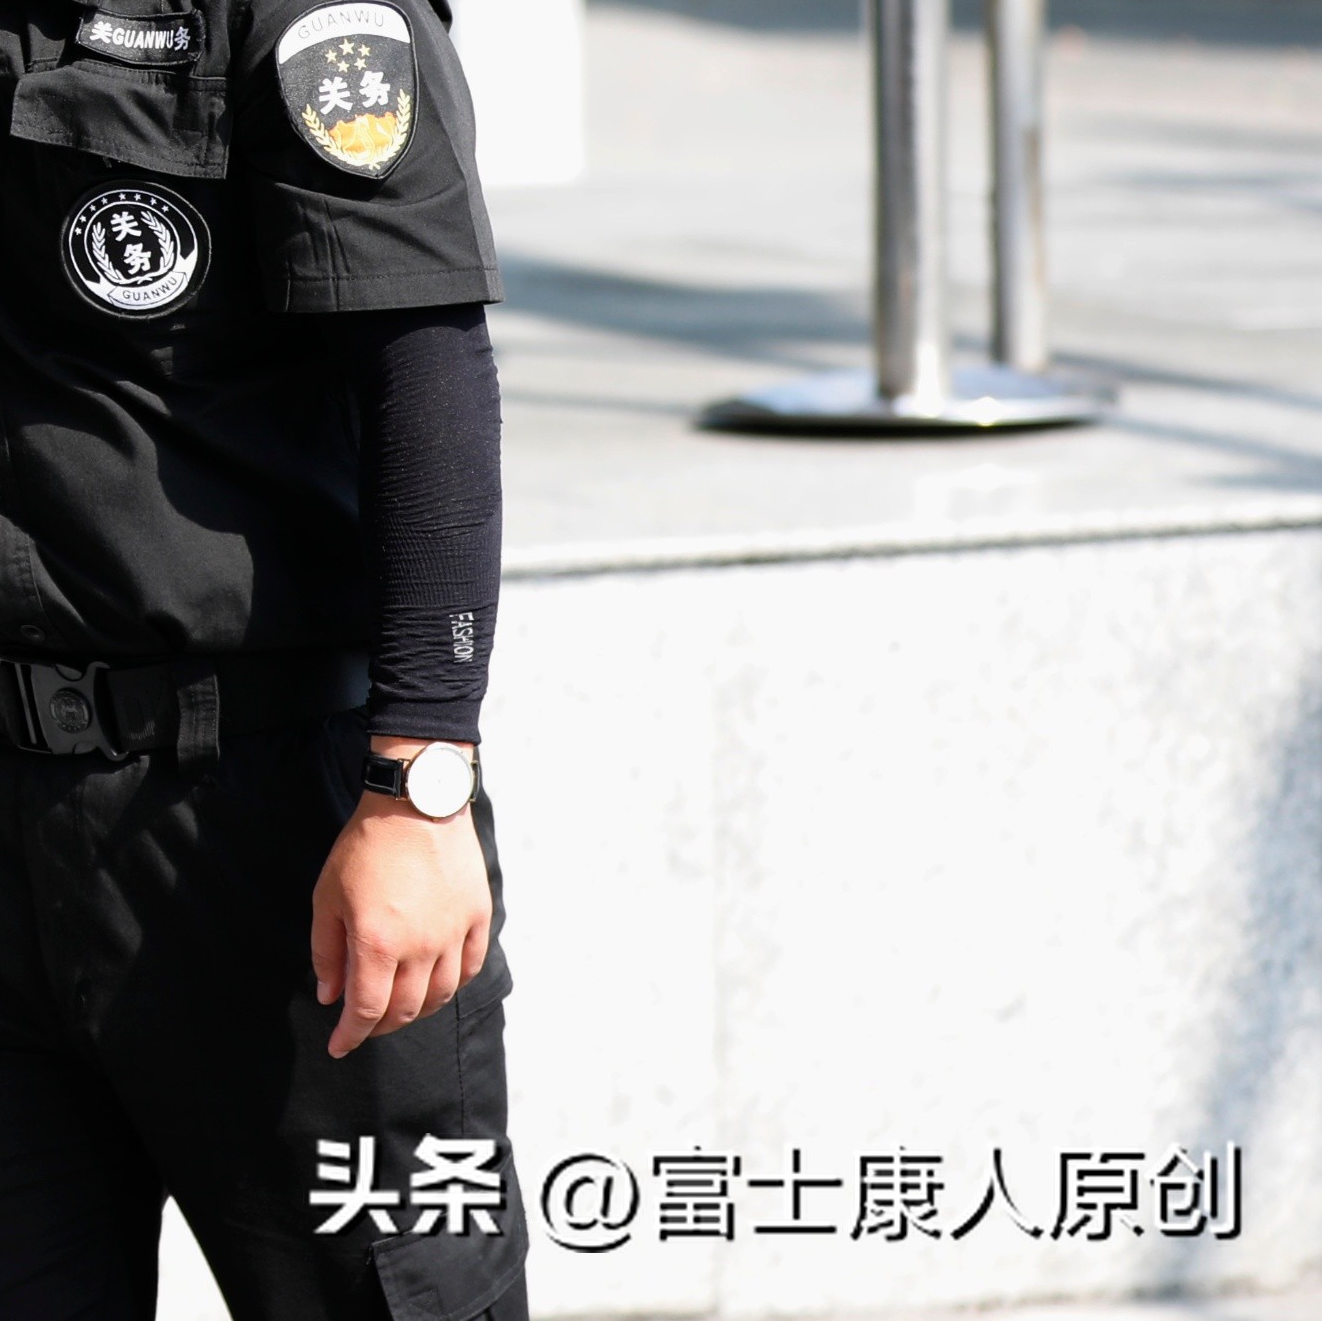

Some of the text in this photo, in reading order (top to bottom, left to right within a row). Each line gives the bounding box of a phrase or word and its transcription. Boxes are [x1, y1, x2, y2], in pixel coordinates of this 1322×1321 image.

[297, 10, 385, 39] GUANWU
[318, 70, 391, 115] 关务
[110, 211, 152, 275] 关务
[122, 277, 178, 302] GUANWU
[449, 612, 474, 663] FASHION
